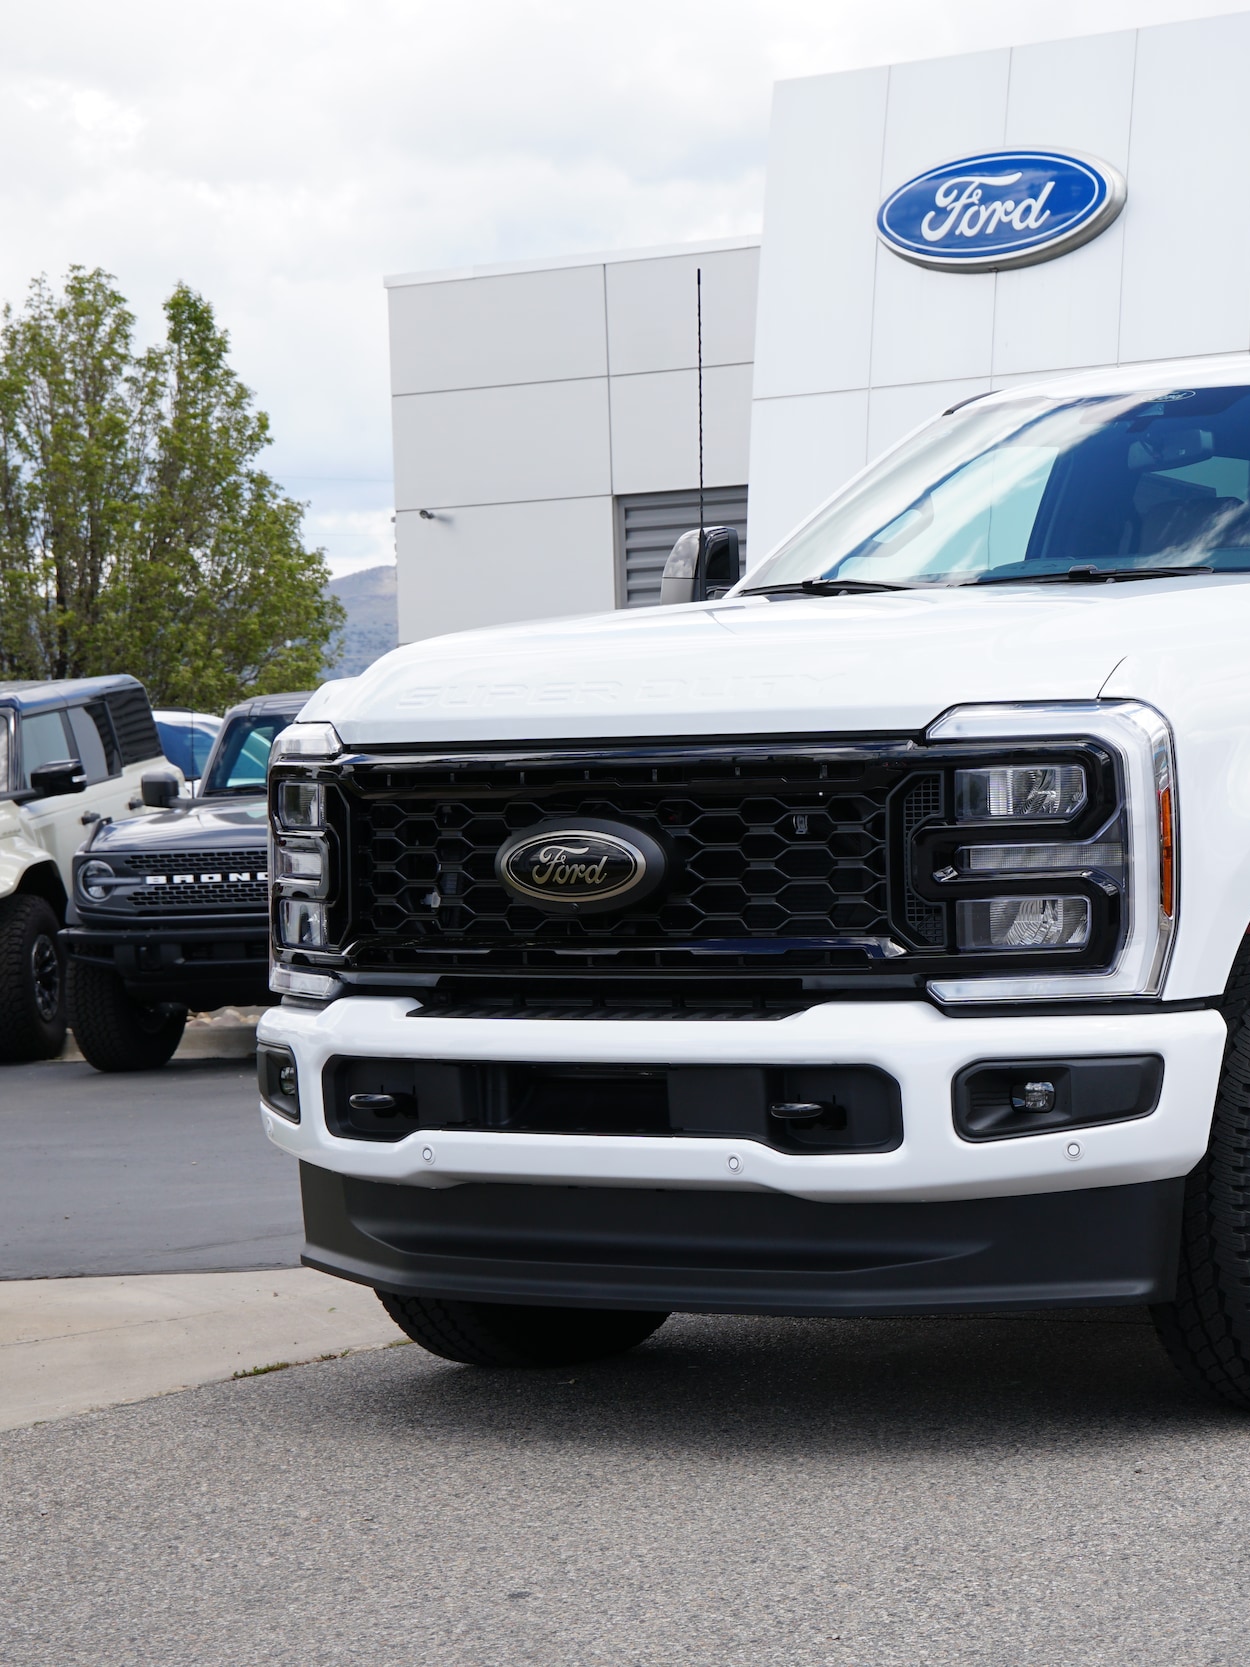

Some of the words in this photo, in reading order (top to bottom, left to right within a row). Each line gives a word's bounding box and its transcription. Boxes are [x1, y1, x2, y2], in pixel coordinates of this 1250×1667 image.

[921, 171, 1056, 242] Ford
[396, 680, 624, 710] SUPER
[633, 673, 847, 702] DUTY
[532, 845, 609, 885] Ford
